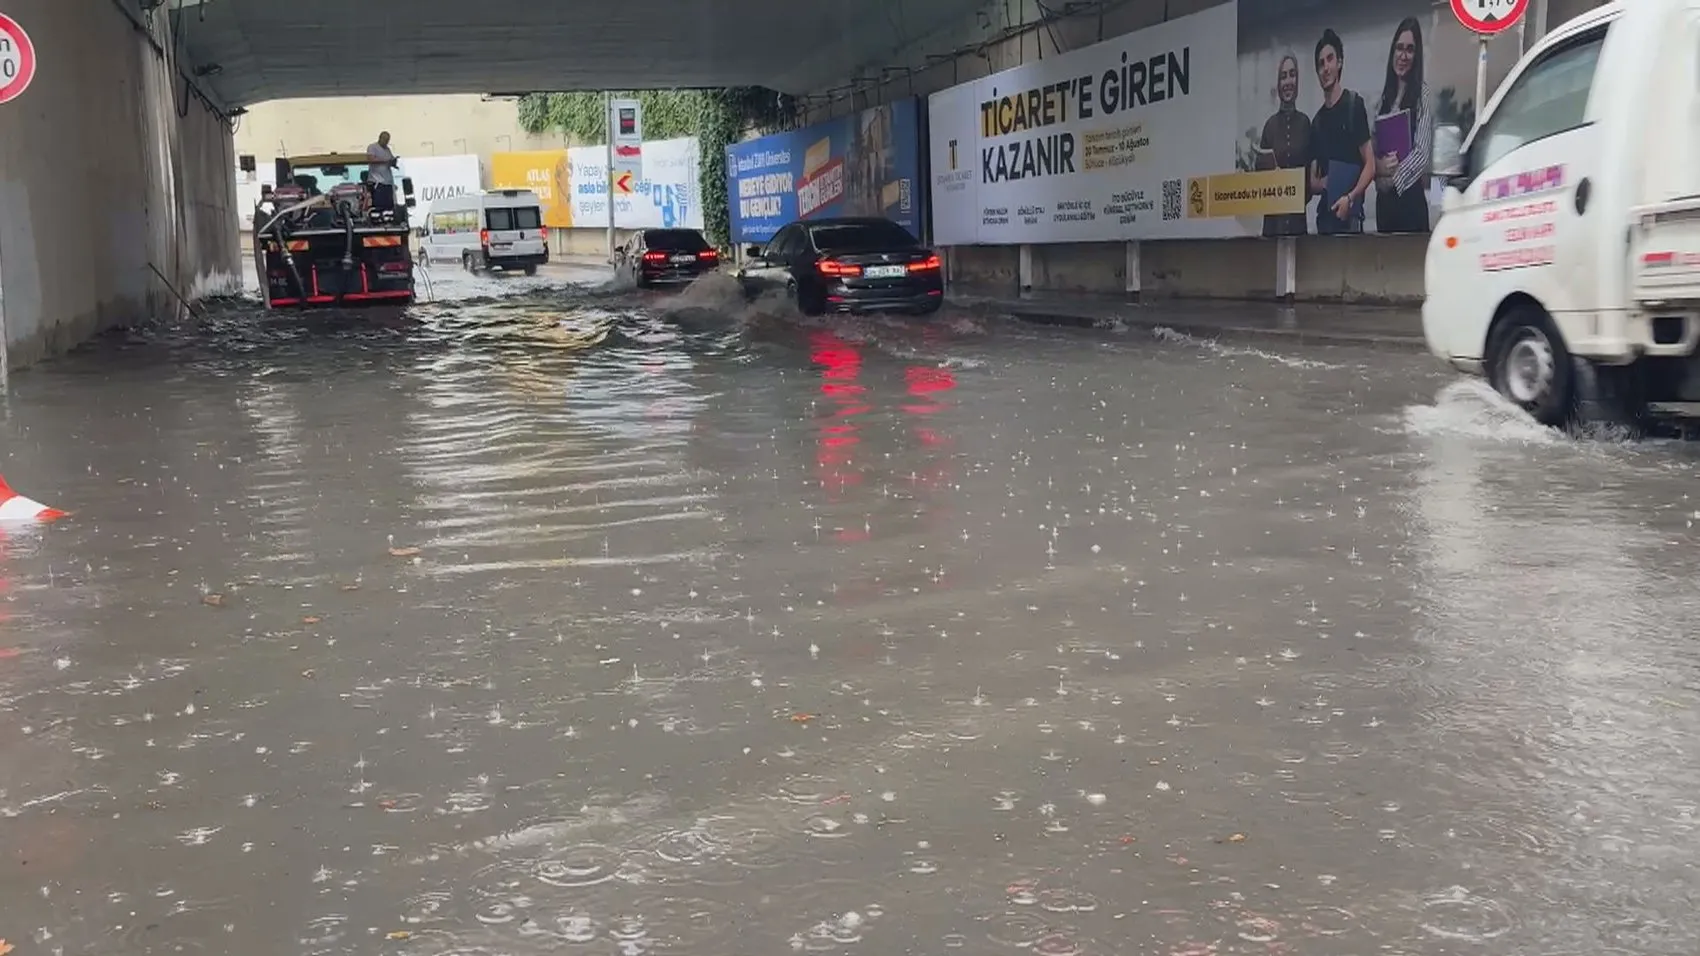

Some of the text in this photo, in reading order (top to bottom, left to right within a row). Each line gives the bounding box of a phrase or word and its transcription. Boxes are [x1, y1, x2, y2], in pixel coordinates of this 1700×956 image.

[1100, 47, 1190, 115] GİREN
[982, 132, 1075, 184] KAZANIR
[1126, 136, 1149, 152] Ağustos
[1214, 188, 1258, 201] ticaret.edu.tr
[1284, 185, 1296, 196] 413
